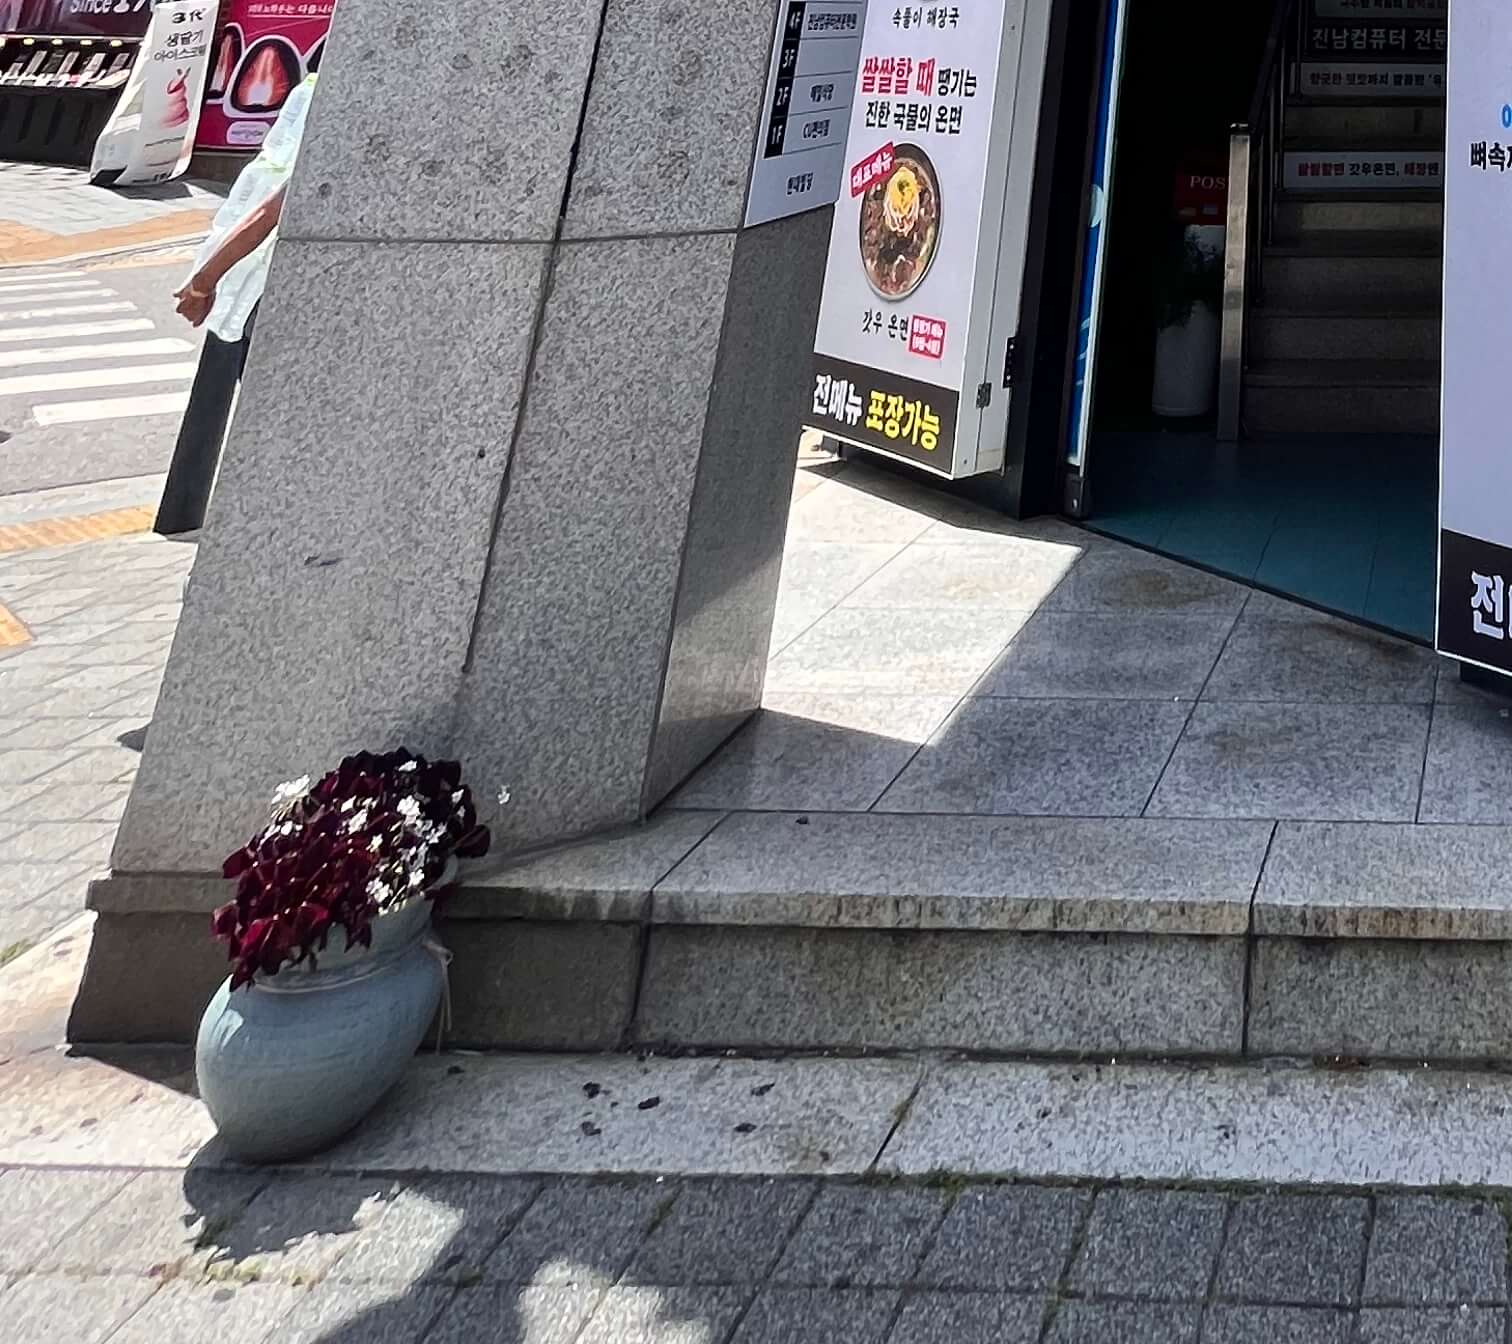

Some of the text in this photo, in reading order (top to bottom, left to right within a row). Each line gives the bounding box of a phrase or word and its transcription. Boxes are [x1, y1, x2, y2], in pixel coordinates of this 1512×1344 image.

[926, 7, 960, 29] 해장국
[1312, 27, 1407, 51] 진남컴퓨터
[783, 49, 795, 68] 3F
[915, 57, 936, 97] 때
[777, 87, 789, 107] 2F
[865, 100, 963, 135] 진한 국물의 온면
[813, 374, 941, 452] 전메뉴 포장가능
